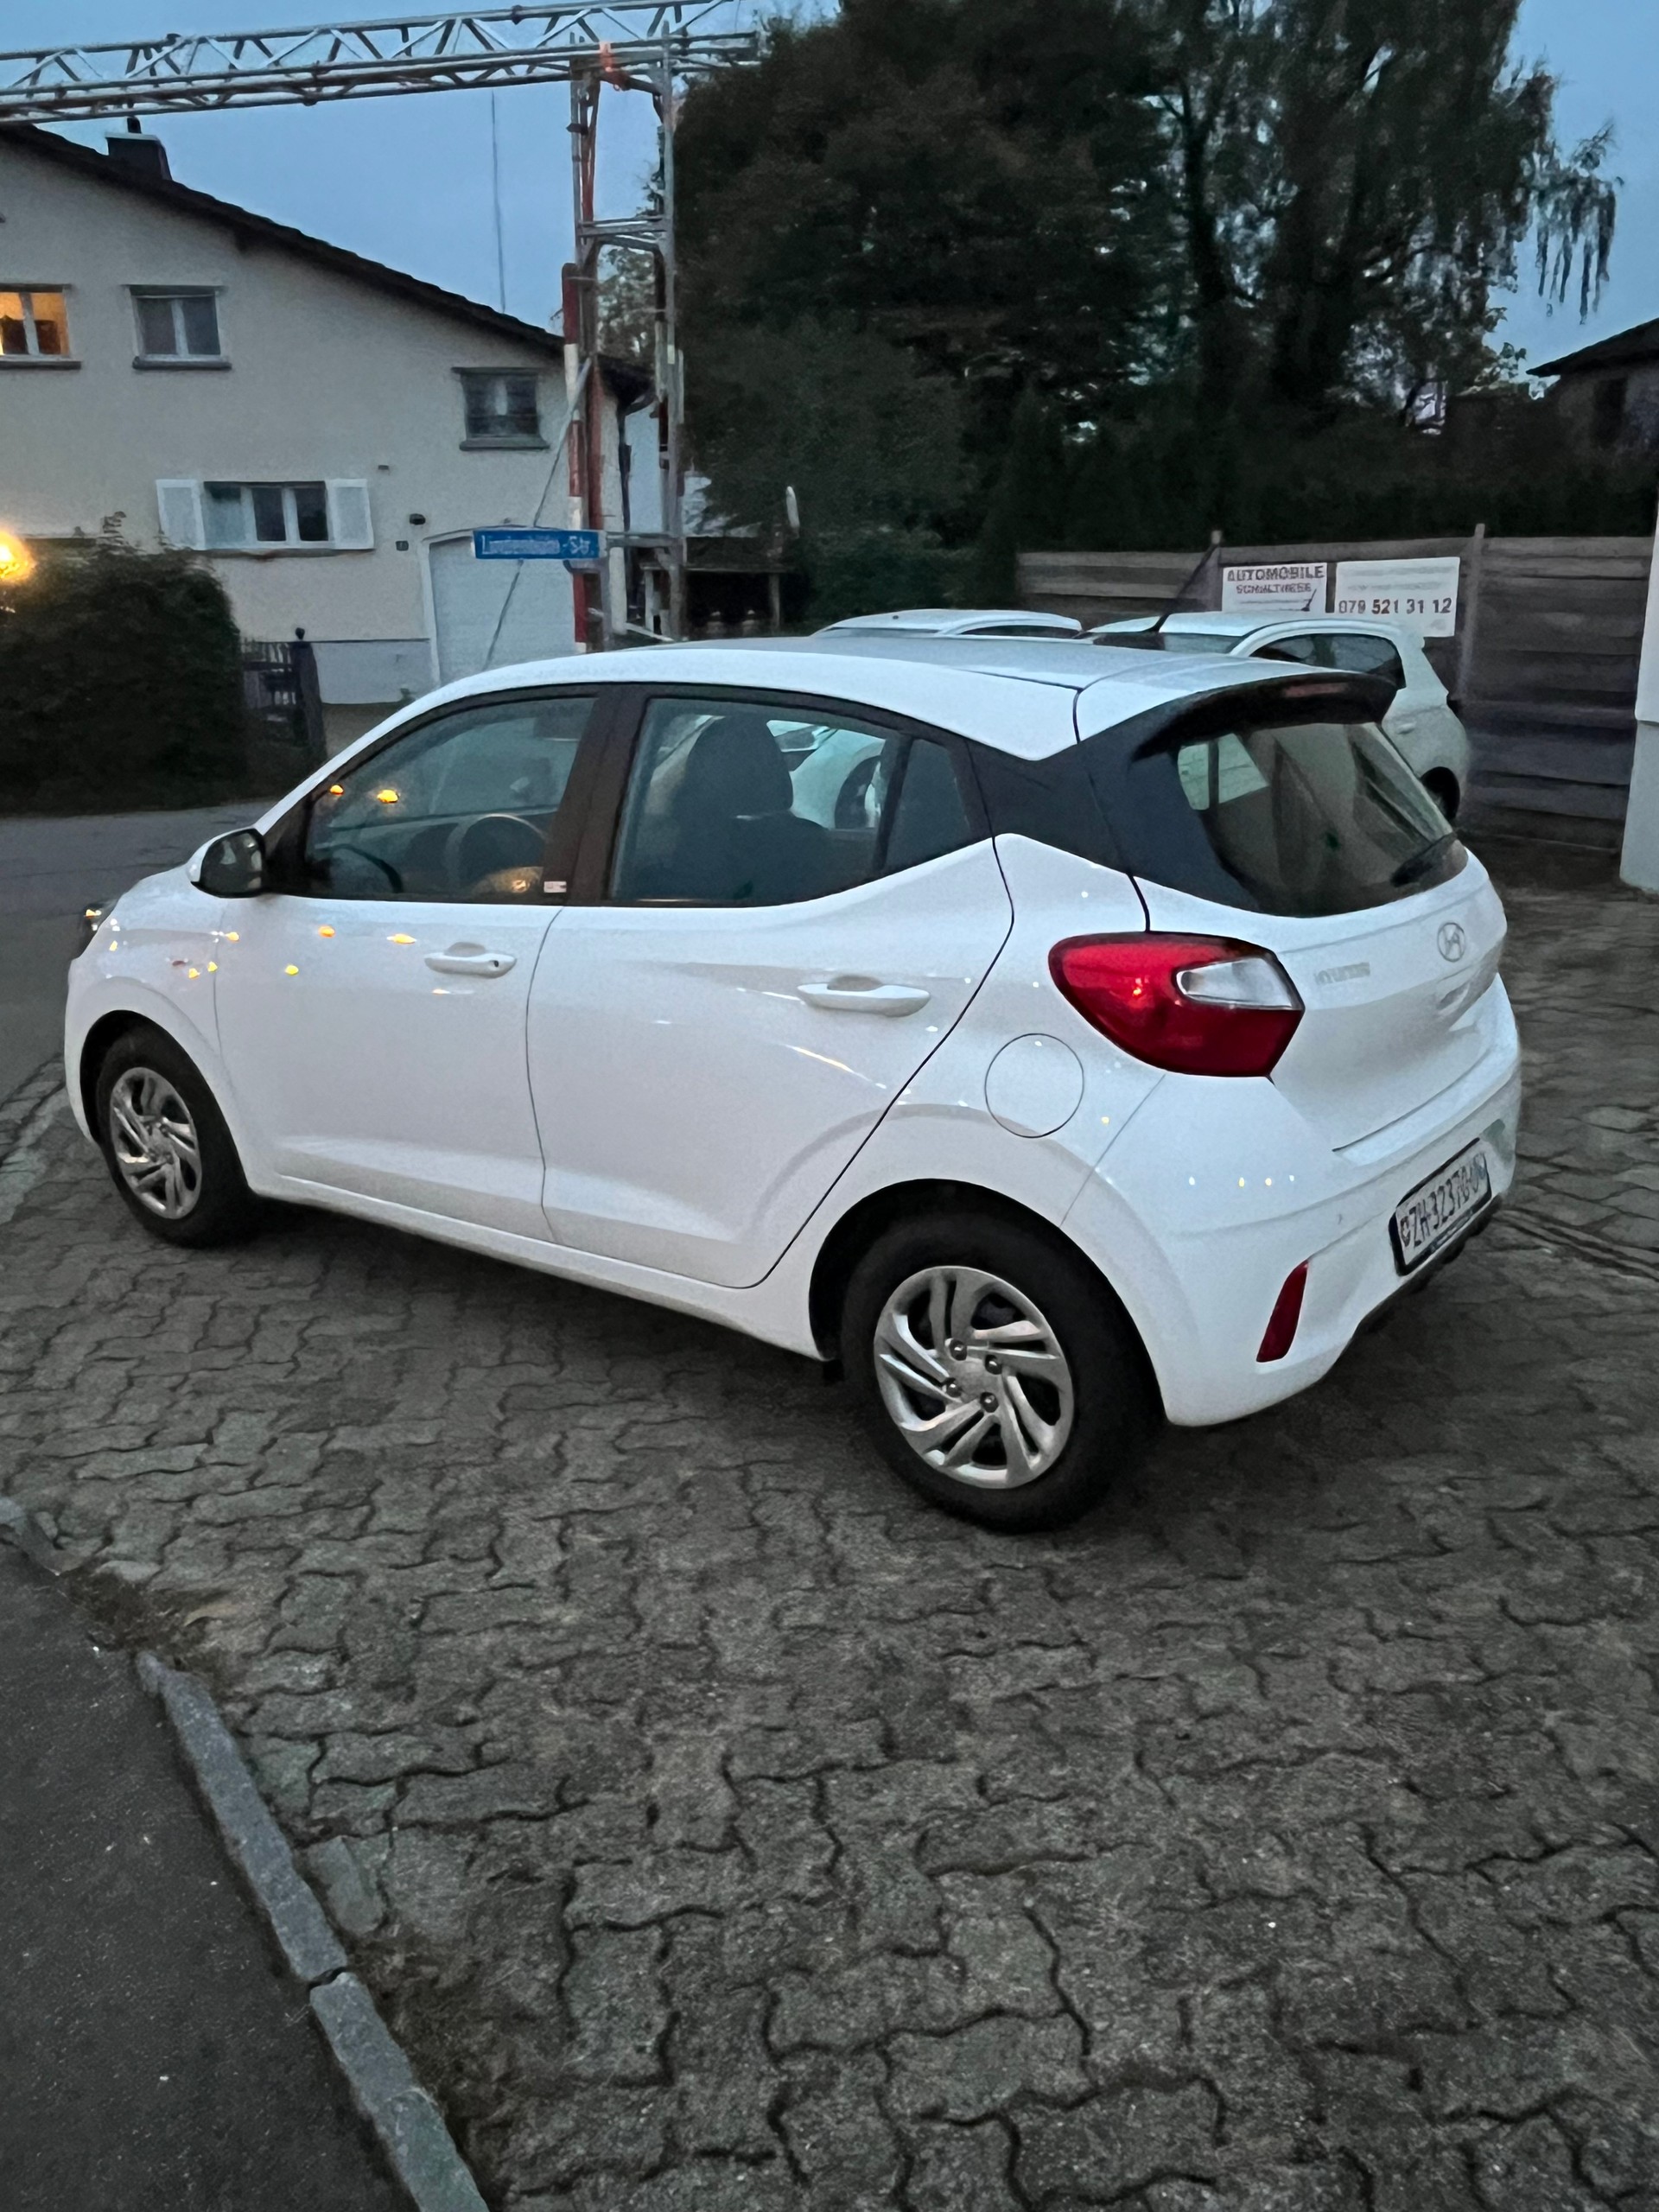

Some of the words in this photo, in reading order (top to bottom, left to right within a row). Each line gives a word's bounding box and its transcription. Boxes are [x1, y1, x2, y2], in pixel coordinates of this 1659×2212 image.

[1227, 565, 1325, 582] AUTOMOBILE
[1371, 598, 1399, 614] 521
[1406, 598, 1424, 614] 31
[1433, 597, 1452, 613] 12
